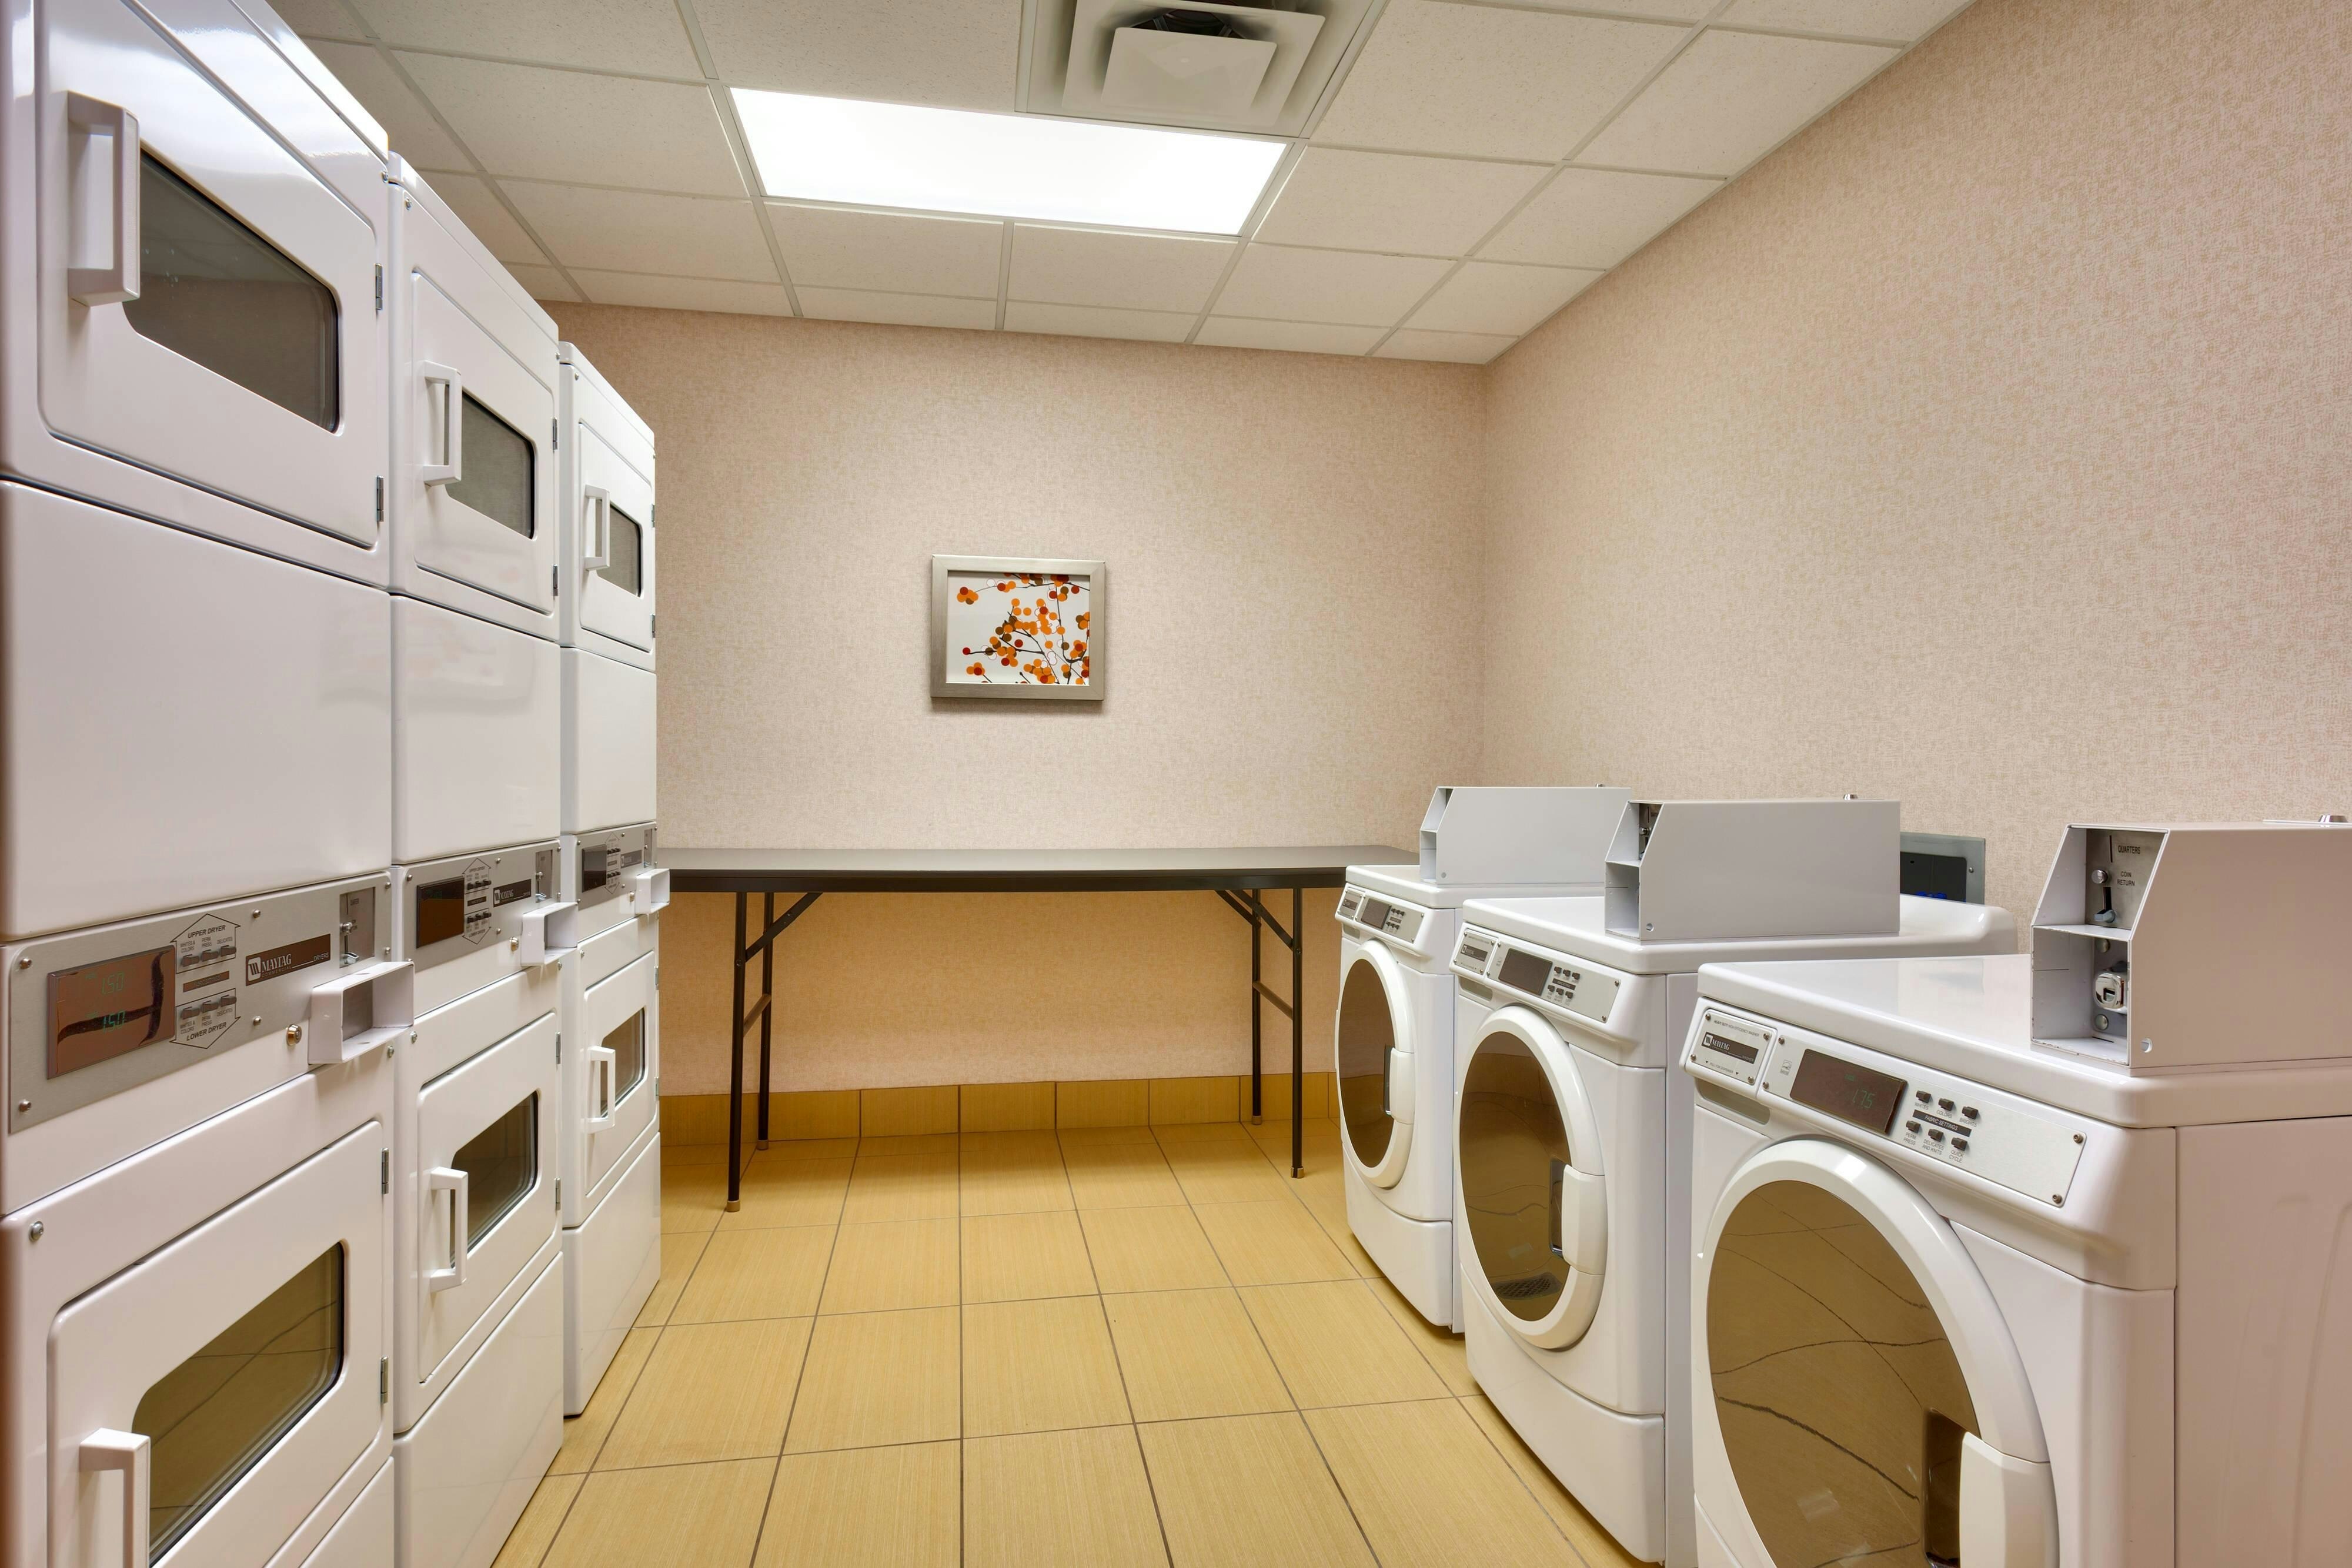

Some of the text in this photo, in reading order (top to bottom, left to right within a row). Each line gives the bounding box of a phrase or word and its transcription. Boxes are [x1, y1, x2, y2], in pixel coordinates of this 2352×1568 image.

[2118, 845, 2141, 854] QUARTERS
[188, 925, 226, 938] UPPER DRYER
[313, 952, 329, 962] DRYERS
[262, 954, 292, 972] MAYTAG
[186, 1022, 226, 1041] LOWER DRYER
[1712, 1039, 1730, 1050] MAYTAG
[1915, 1102, 1929, 1111] WHITES
[1936, 1110, 1953, 1119] COLORS
[1925, 1115, 1958, 1131] FABRIC SETTINGS
[1959, 1118, 1977, 1127] BRIGHTS
[1903, 1137, 1916, 1146] PRESS
[1923, 1139, 1944, 1150] DELICATES
[1931, 1147, 1943, 1155] KNITS
[1951, 1149, 1964, 1158] QUICK
[1949, 1155, 1963, 1164] CYCLE
